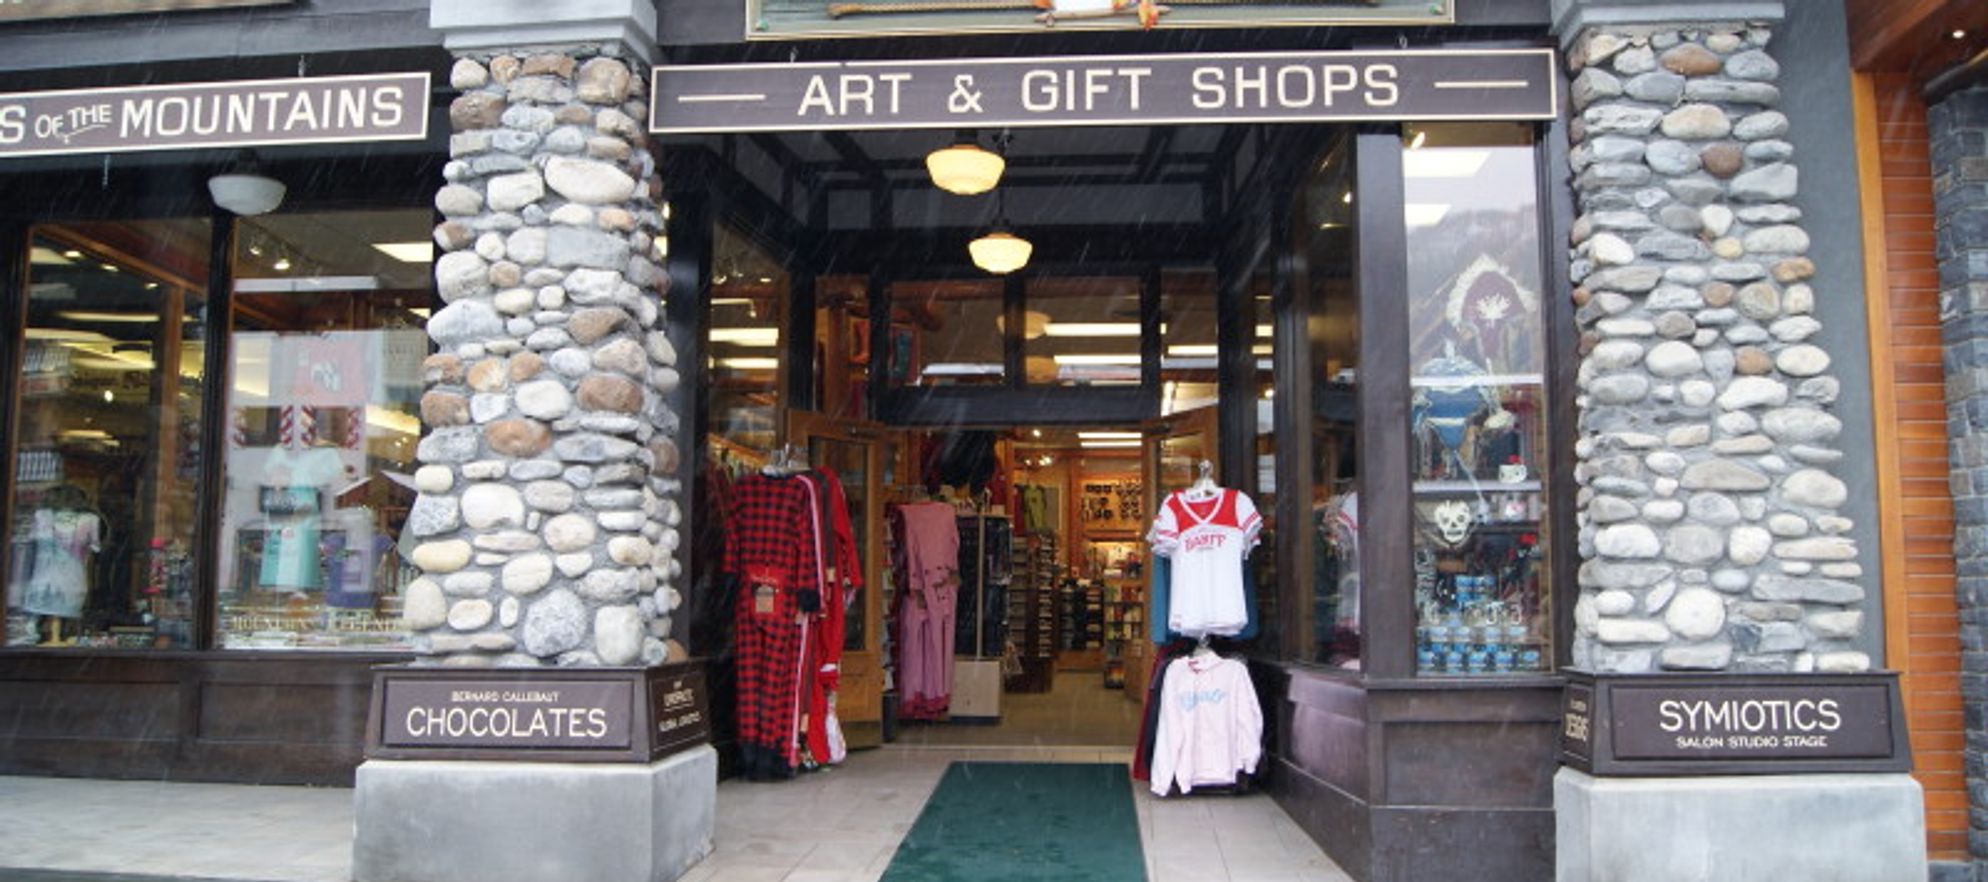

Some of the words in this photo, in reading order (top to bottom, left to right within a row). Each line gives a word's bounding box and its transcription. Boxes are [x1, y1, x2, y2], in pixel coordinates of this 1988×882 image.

[797, 72, 912, 116] ART
[947, 74, 984, 113] &
[1020, 68, 1152, 112] GIFT
[1192, 63, 1400, 109] SHOPS
[34, 114, 64, 139] OF
[67, 103, 113, 129] THE
[119, 86, 404, 138] MOUNTAINS
[452, 691, 500, 702] BERNARD
[501, 691, 560, 702] CALLEBAUT
[406, 706, 609, 738] CHOCOLATES
[1659, 699, 1842, 732] SYMIOTICS
[1675, 735, 1724, 749] SALON
[1726, 735, 1779, 748] STUDIO
[1782, 734, 1828, 748] STAGE
